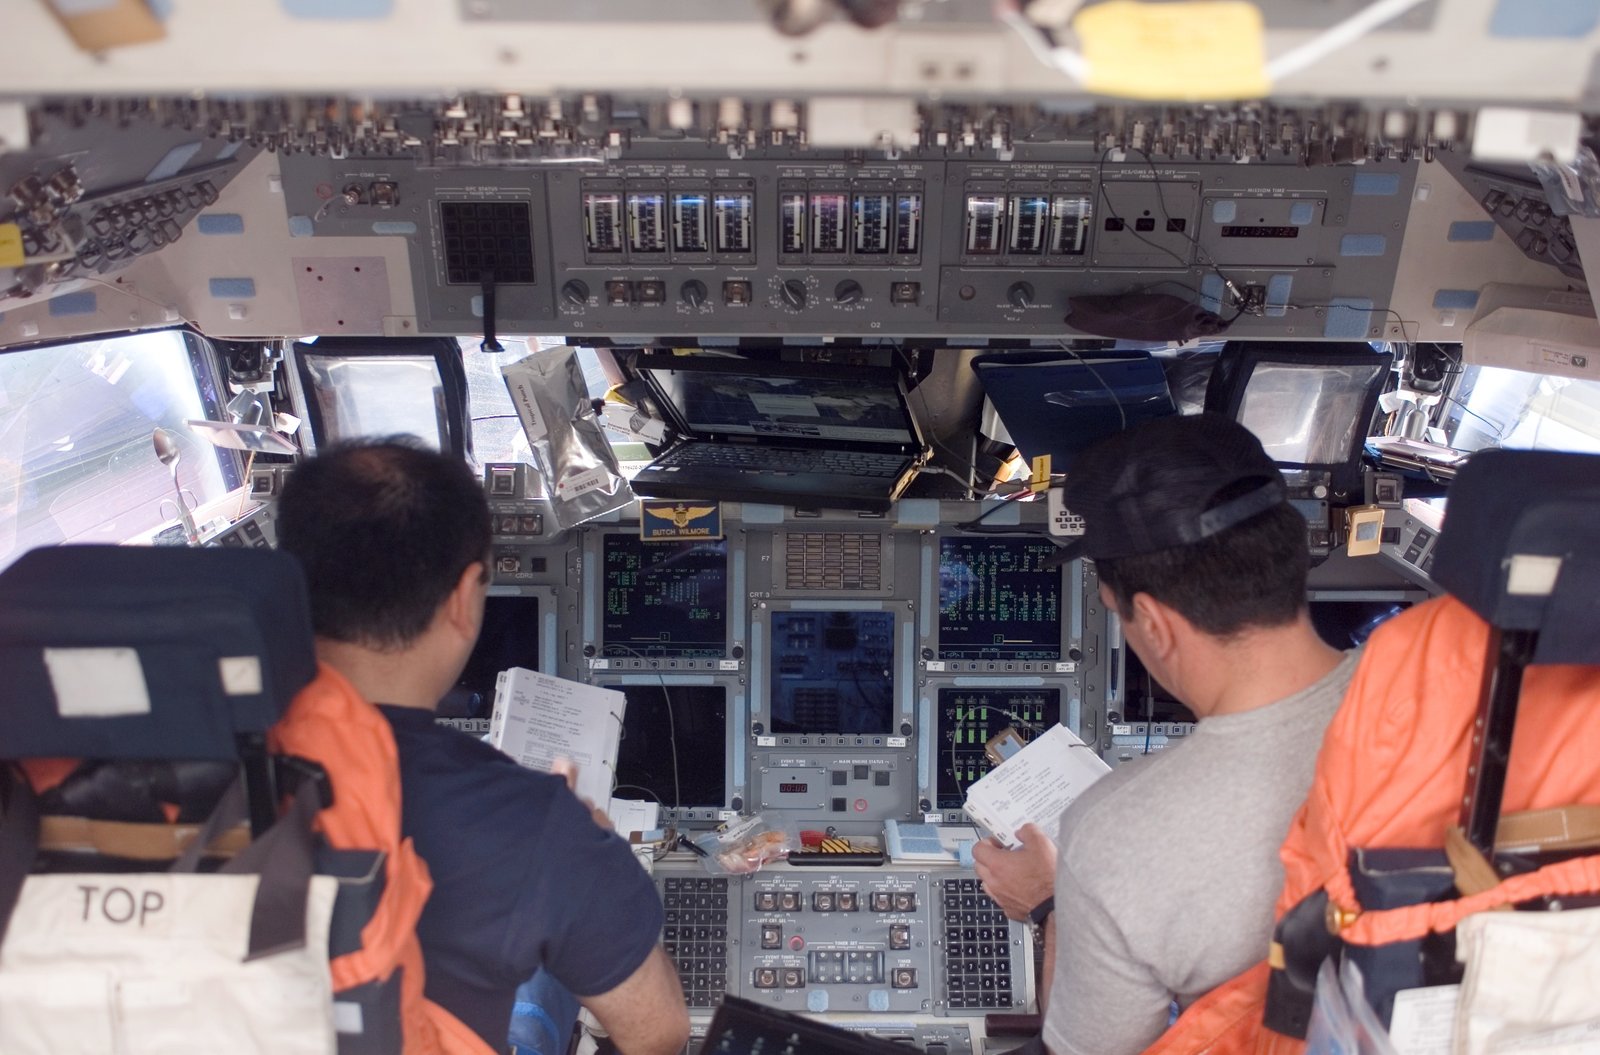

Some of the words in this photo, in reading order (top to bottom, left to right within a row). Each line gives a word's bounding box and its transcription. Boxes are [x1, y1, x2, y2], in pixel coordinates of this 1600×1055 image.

[518, 384, 530, 403] Punch
[524, 402, 537, 426] Tropical
[78, 885, 165, 928] TOP
